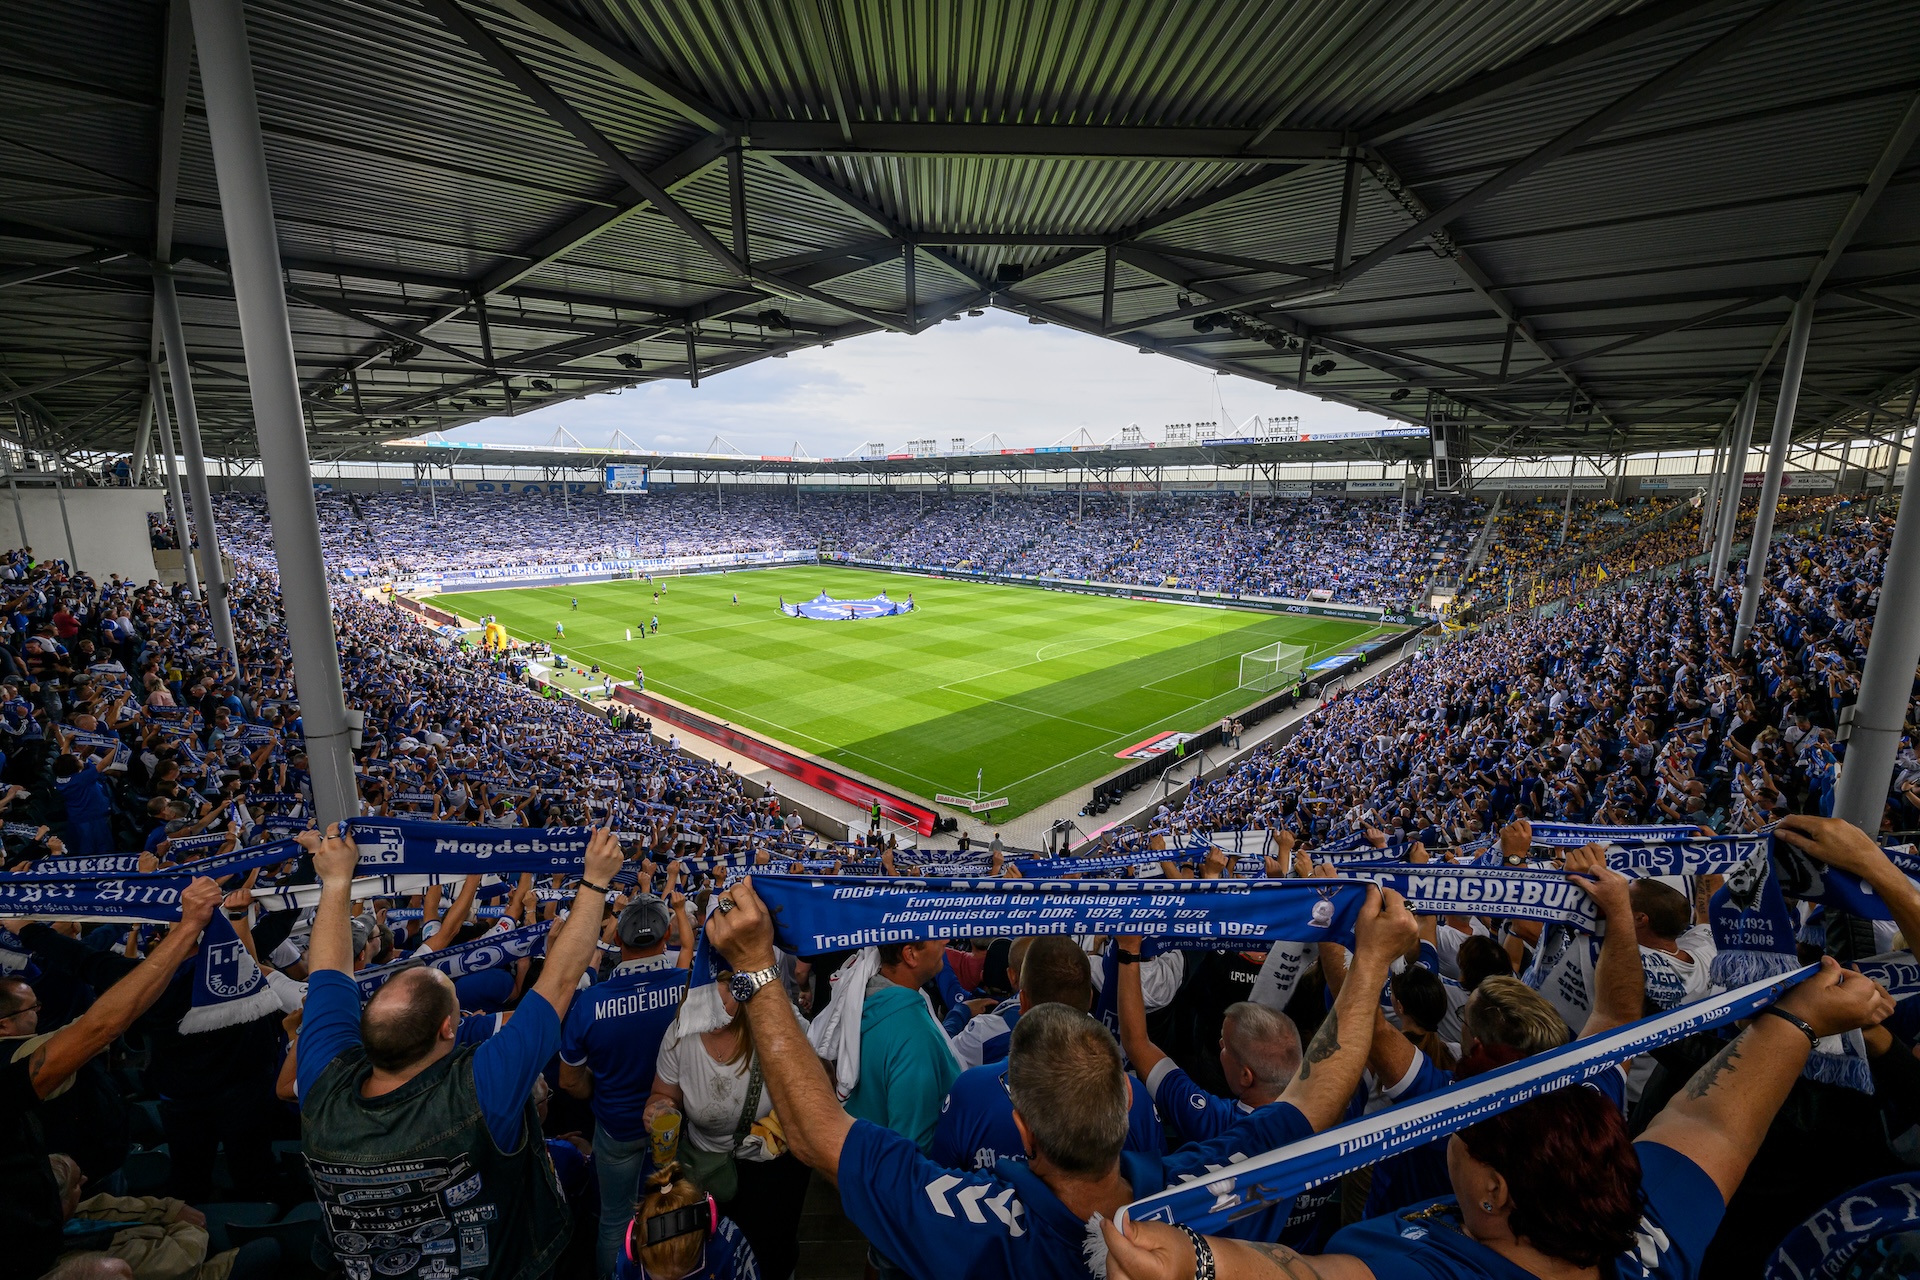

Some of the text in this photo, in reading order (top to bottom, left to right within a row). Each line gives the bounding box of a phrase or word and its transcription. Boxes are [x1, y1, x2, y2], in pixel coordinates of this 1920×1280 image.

[1286, 605, 1302, 613] AOK
[1379, 614, 1397, 623] AOK
[434, 838, 585, 859] Magdebur
[1475, 869, 1563, 881] SACHSEN-ANHAL
[906, 893, 1186, 909] Europapokal der Pokalsieger: 1974
[1406, 875, 1598, 920] MAGDEBURG
[881, 909, 1005, 924] Fußballmeister
[1007, 908, 1034, 920] der
[1039, 907, 1078, 919] DDR:
[1414, 902, 1457, 910] SIEGER
[1467, 903, 1561, 919] SACHSEN-ANHALT
[813, 927, 921, 950] Tradition,
[928, 922, 1068, 939] Leidenschaft
[1073, 922, 1088, 934] &
[1094, 921, 1167, 935] Erfolge
[1174, 920, 1213, 935] seit
